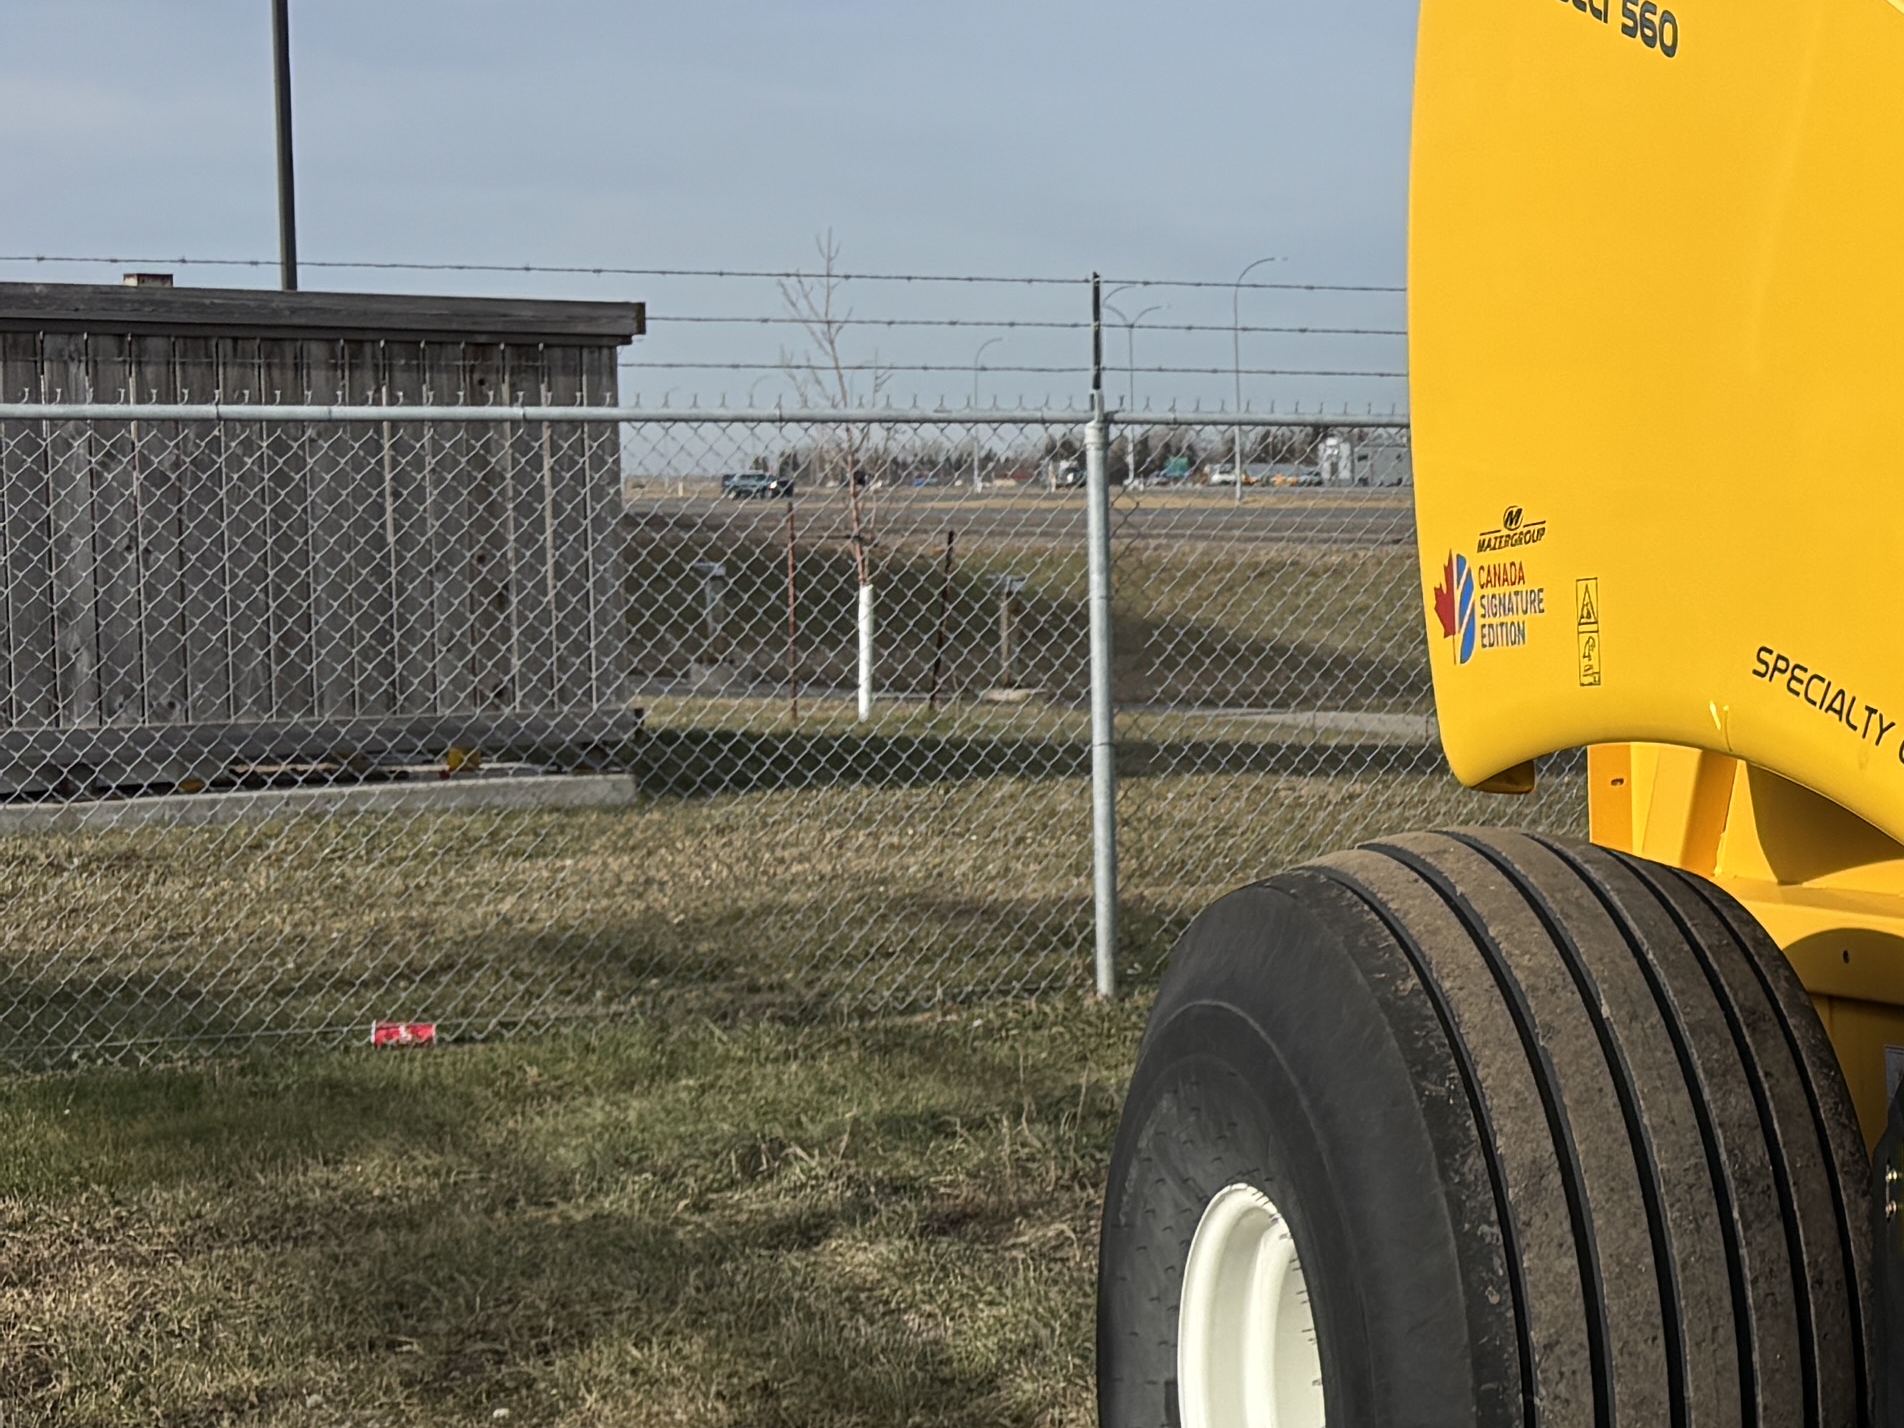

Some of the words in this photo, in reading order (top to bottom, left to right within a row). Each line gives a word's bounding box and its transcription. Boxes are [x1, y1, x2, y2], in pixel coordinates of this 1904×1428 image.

[1477, 527, 1546, 553] MAZERGROUP
[1478, 560, 1526, 590] CANADA
[1480, 587, 1545, 619] SIGNATURE
[1480, 620, 1526, 649] EDITION
[1752, 645, 1896, 747] SPECIALTY
